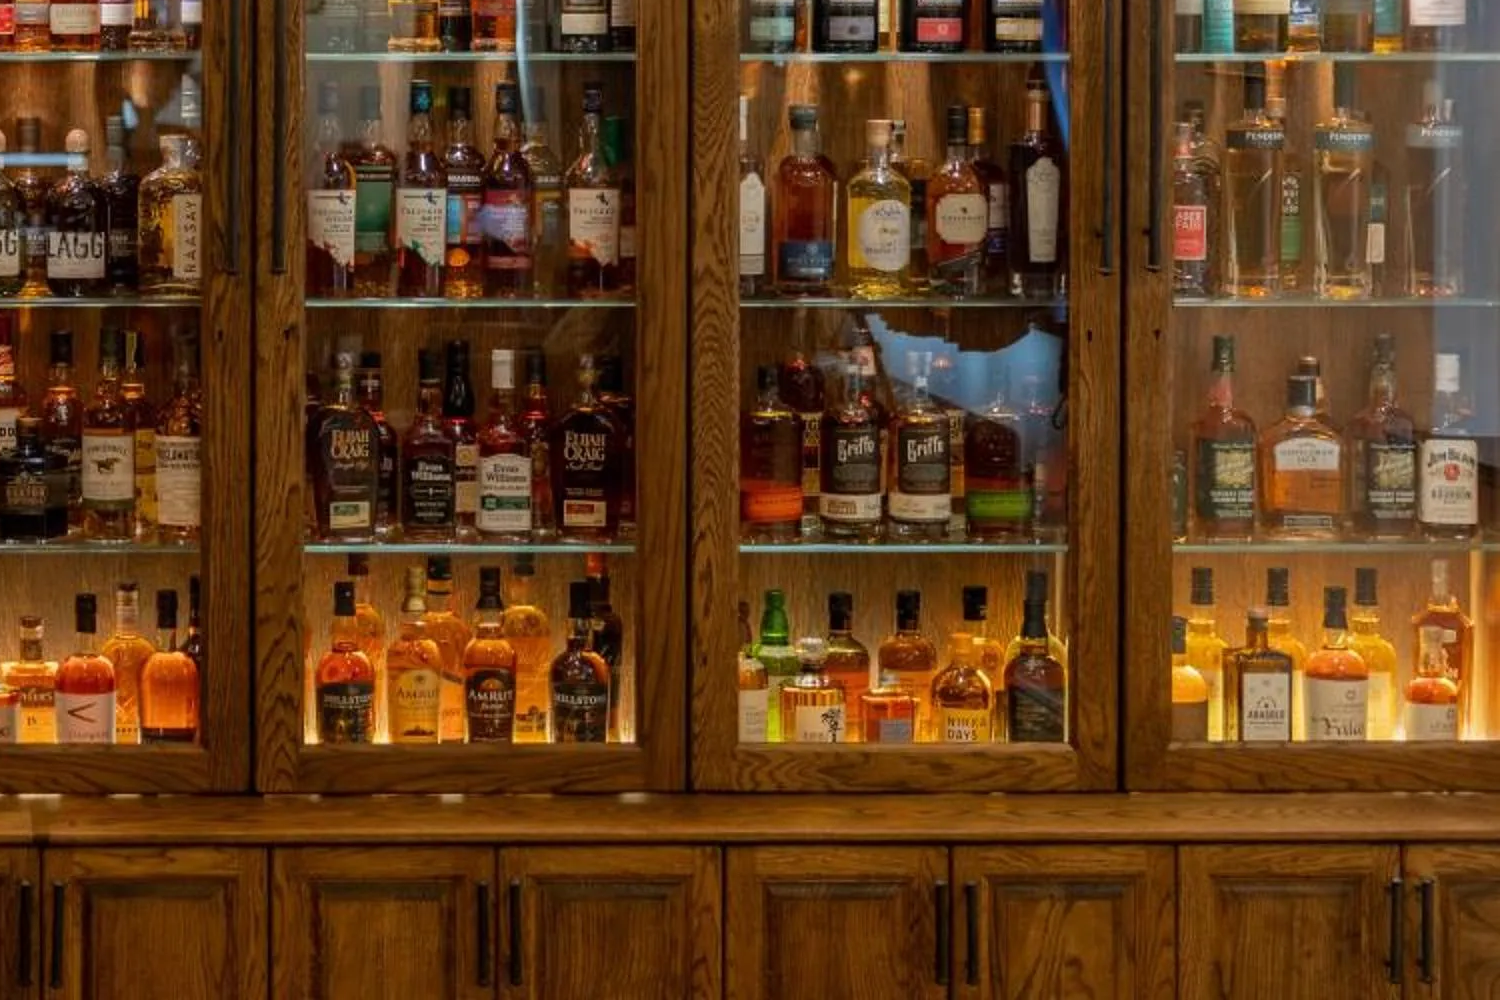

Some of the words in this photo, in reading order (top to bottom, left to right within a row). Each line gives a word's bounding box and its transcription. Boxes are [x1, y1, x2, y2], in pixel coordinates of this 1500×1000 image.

[47, 231, 103, 259] LAGG
[184, 201, 199, 275] RAASAY
[331, 428, 369, 444] ELIJAH
[563, 430, 605, 447] ELIJAH
[330, 443, 369, 461] CRAIG
[563, 445, 605, 463] CRAIG
[491, 462, 519, 474] Evan
[483, 473, 528, 485] Williams
[468, 688, 514, 702] AMRUT
[946, 716, 986, 728] NIKKA
[946, 728, 978, 742] DAYS
